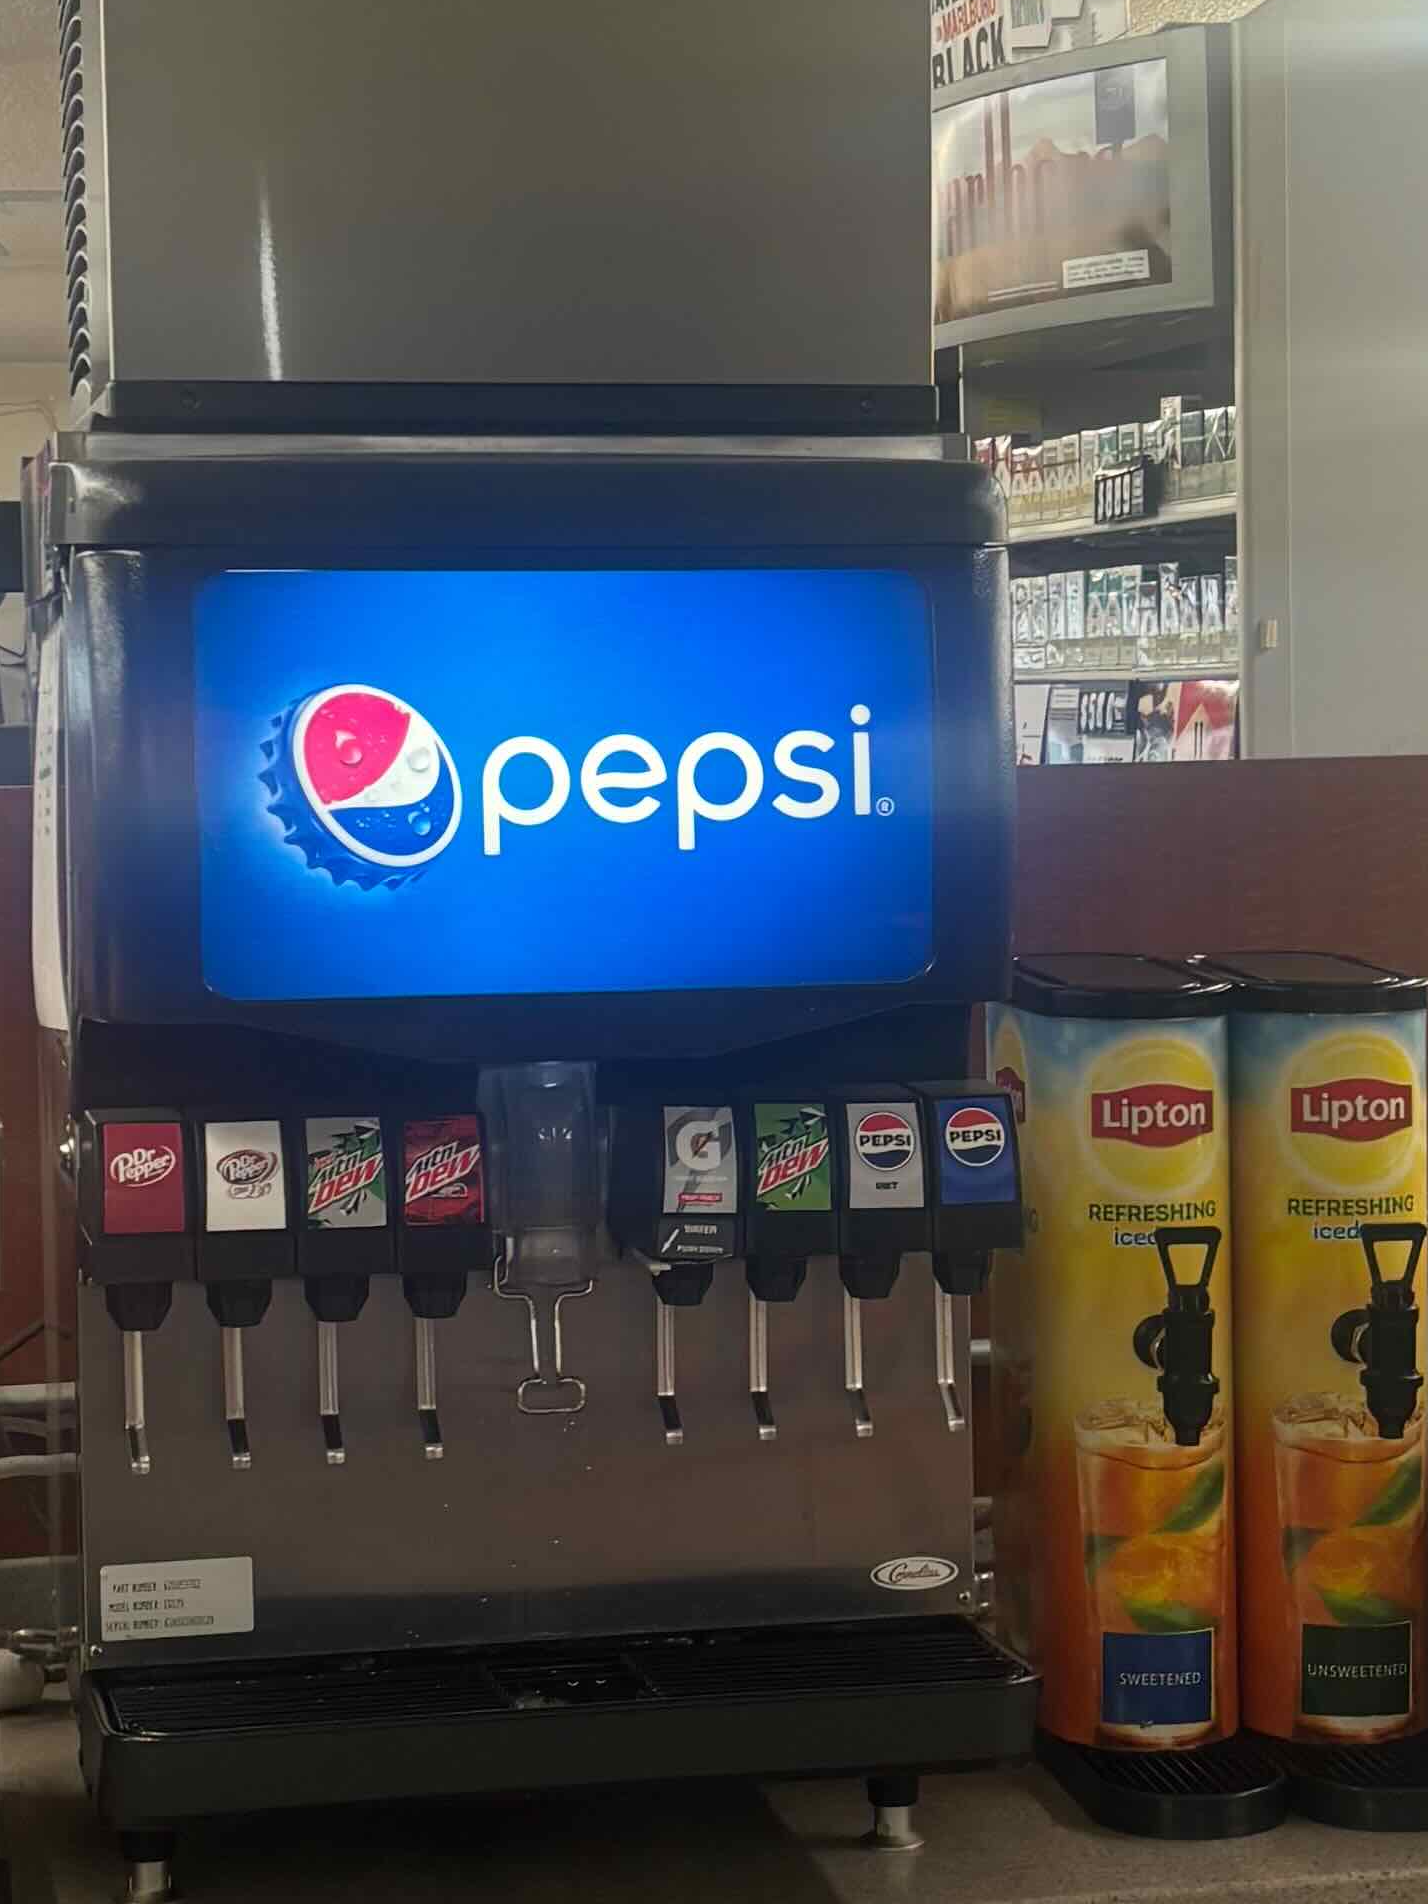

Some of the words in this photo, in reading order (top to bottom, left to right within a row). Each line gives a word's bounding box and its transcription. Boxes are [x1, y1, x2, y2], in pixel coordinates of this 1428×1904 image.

[931, 15, 1006, 90] BLACK
[482, 703, 872, 856] pepsi
[1102, 1097, 1206, 1135] Lipton
[1302, 1092, 1405, 1129] Lipton
[675, 1120, 721, 1171] G
[859, 1135, 912, 1148] PEPSI
[949, 1130, 1002, 1144] PEPSI
[133, 1148, 157, 1163] Dr
[240, 1155, 259, 1167] Dr
[114, 1153, 171, 1183] Pepper
[228, 1158, 269, 1181] Pepper
[1087, 1200, 1217, 1222] REFRESHING
[1287, 1195, 1414, 1216] REFRESHING
[1119, 1671, 1202, 1687] SWEETENED
[1307, 1663, 1408, 1679] UNSWEETENED
